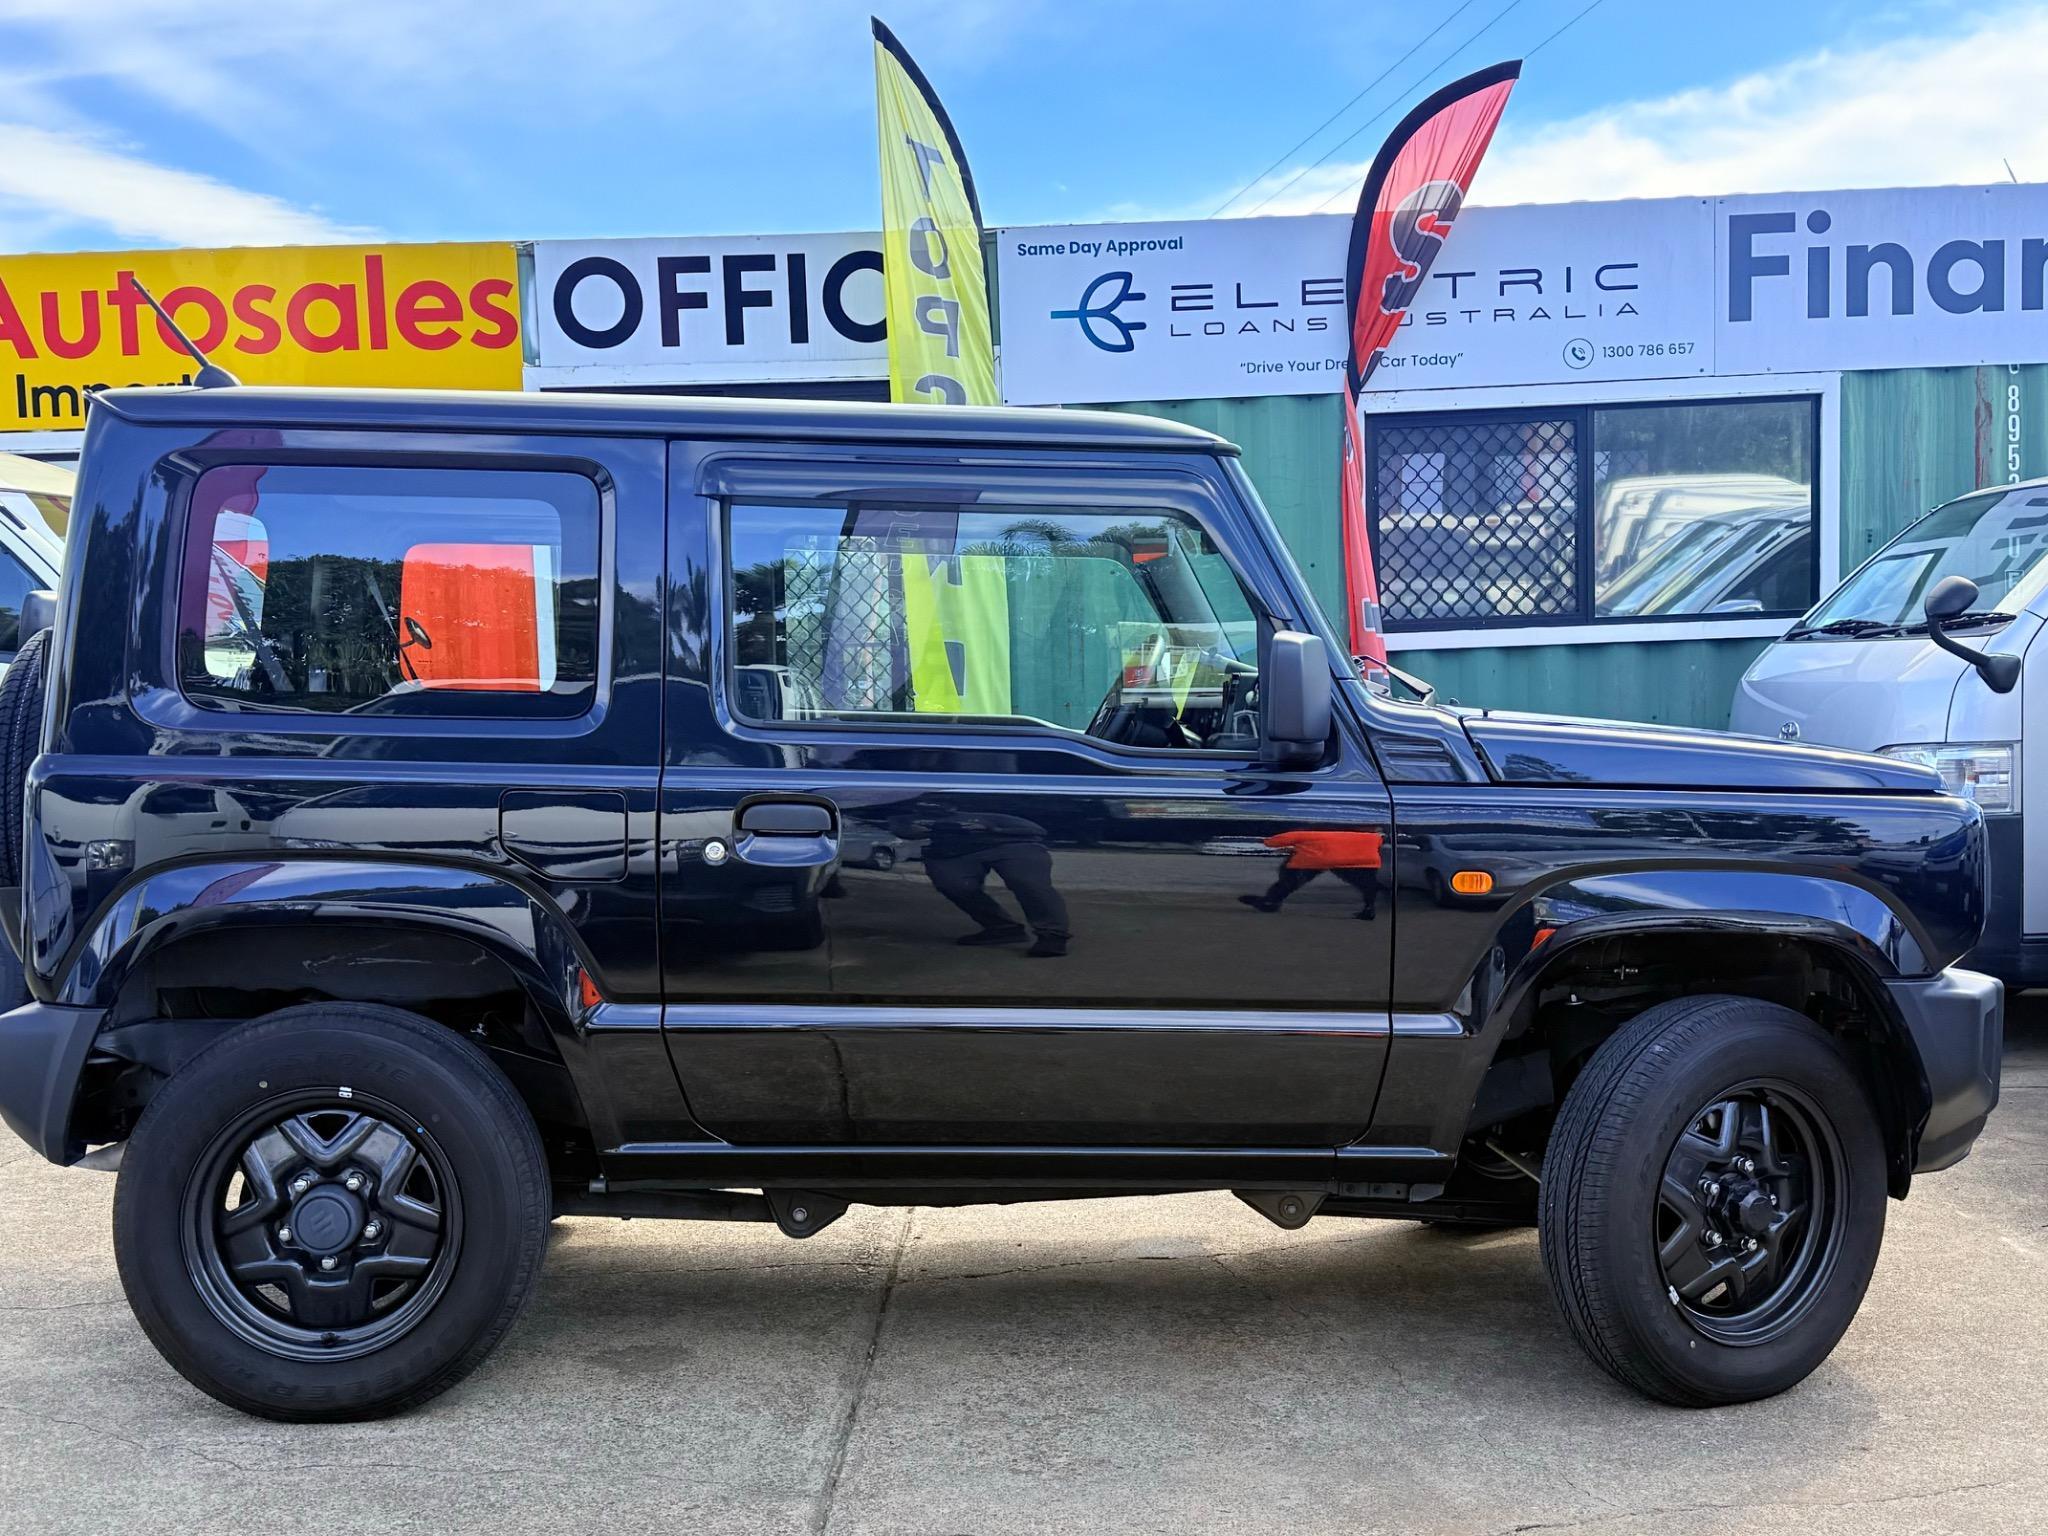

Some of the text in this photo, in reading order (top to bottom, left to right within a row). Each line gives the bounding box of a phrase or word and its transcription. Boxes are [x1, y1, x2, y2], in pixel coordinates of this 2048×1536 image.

[1017, 236, 1183, 257] Same Day Approval
[553, 250, 889, 349] OFFIC
[1171, 262, 1639, 312] ELETRIC
[1170, 302, 1640, 337] LOANS USTRALIA
[1288, 360, 1322, 372] Your
[1325, 358, 1348, 371] Dre
[1380, 356, 1407, 368] Car
[1602, 342, 1695, 358] 1300 786 657
